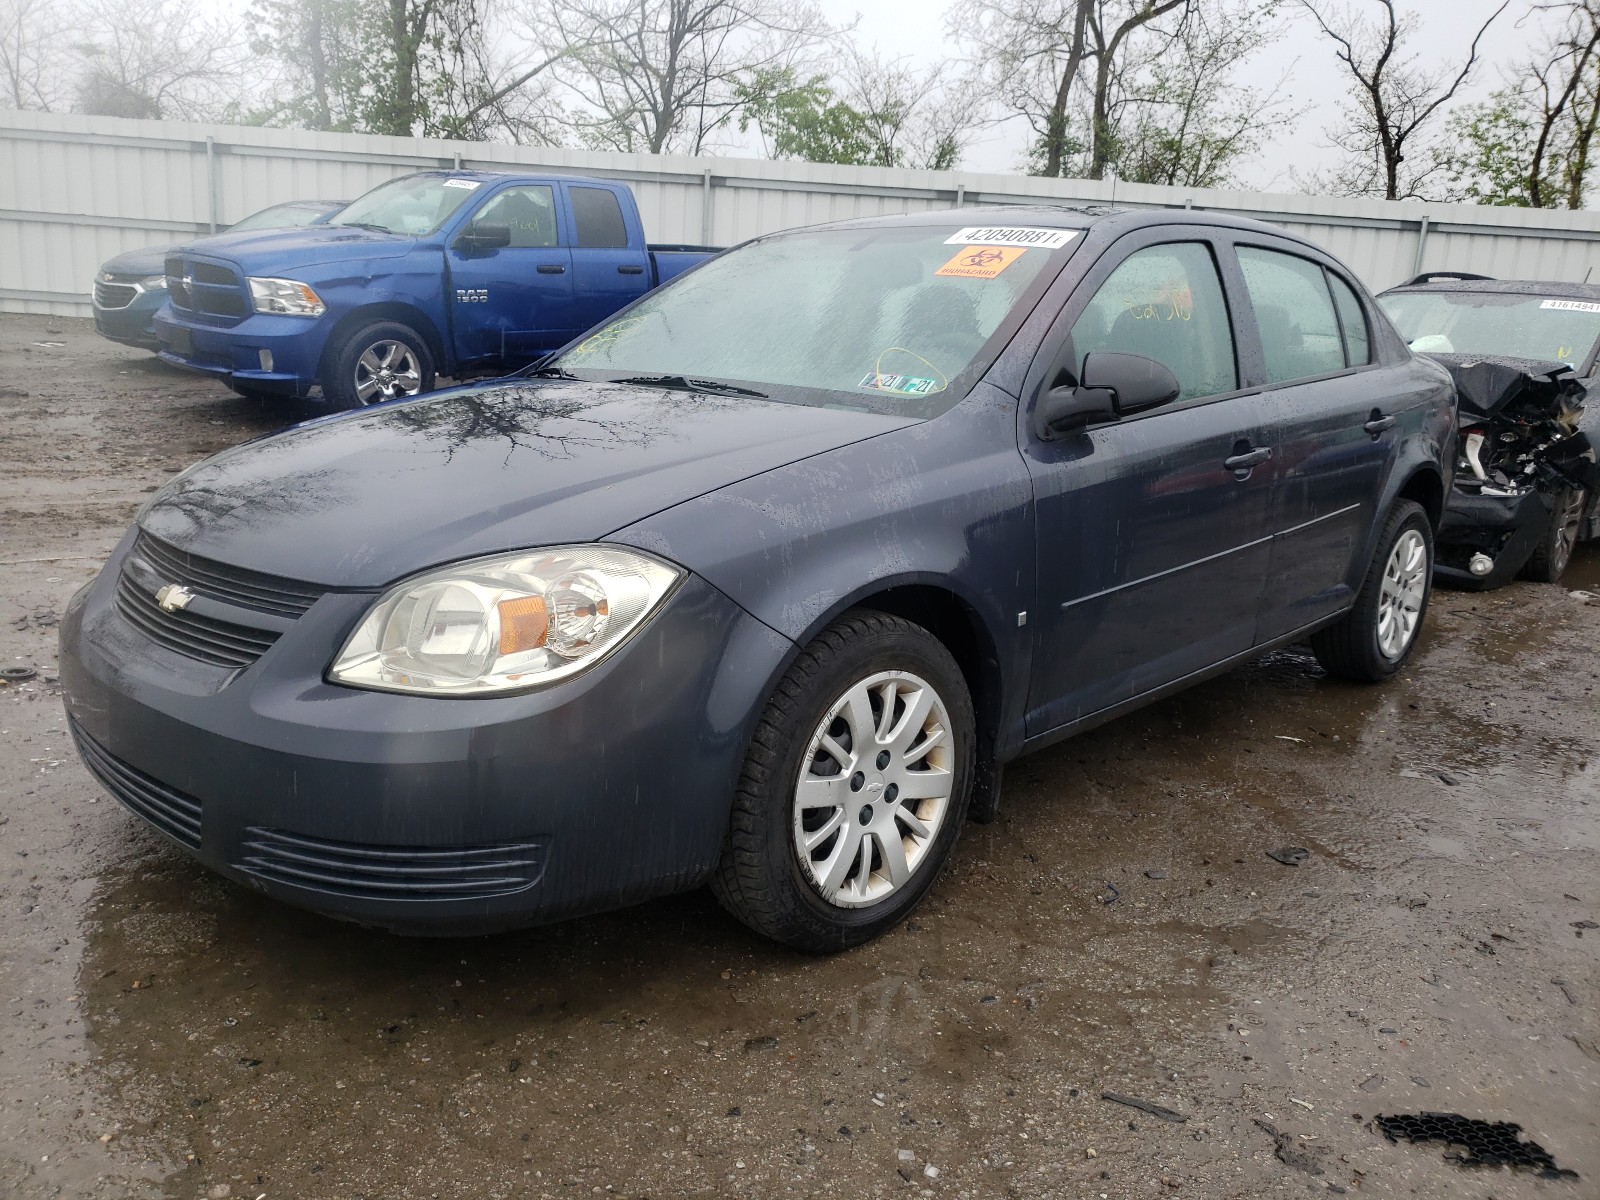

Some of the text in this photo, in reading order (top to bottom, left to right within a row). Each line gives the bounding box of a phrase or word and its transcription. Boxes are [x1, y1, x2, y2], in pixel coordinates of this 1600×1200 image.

[965, 229, 1057, 244] 42090881
[941, 267, 997, 276] BIOHAZARD
[456, 295, 488, 303] 1500
